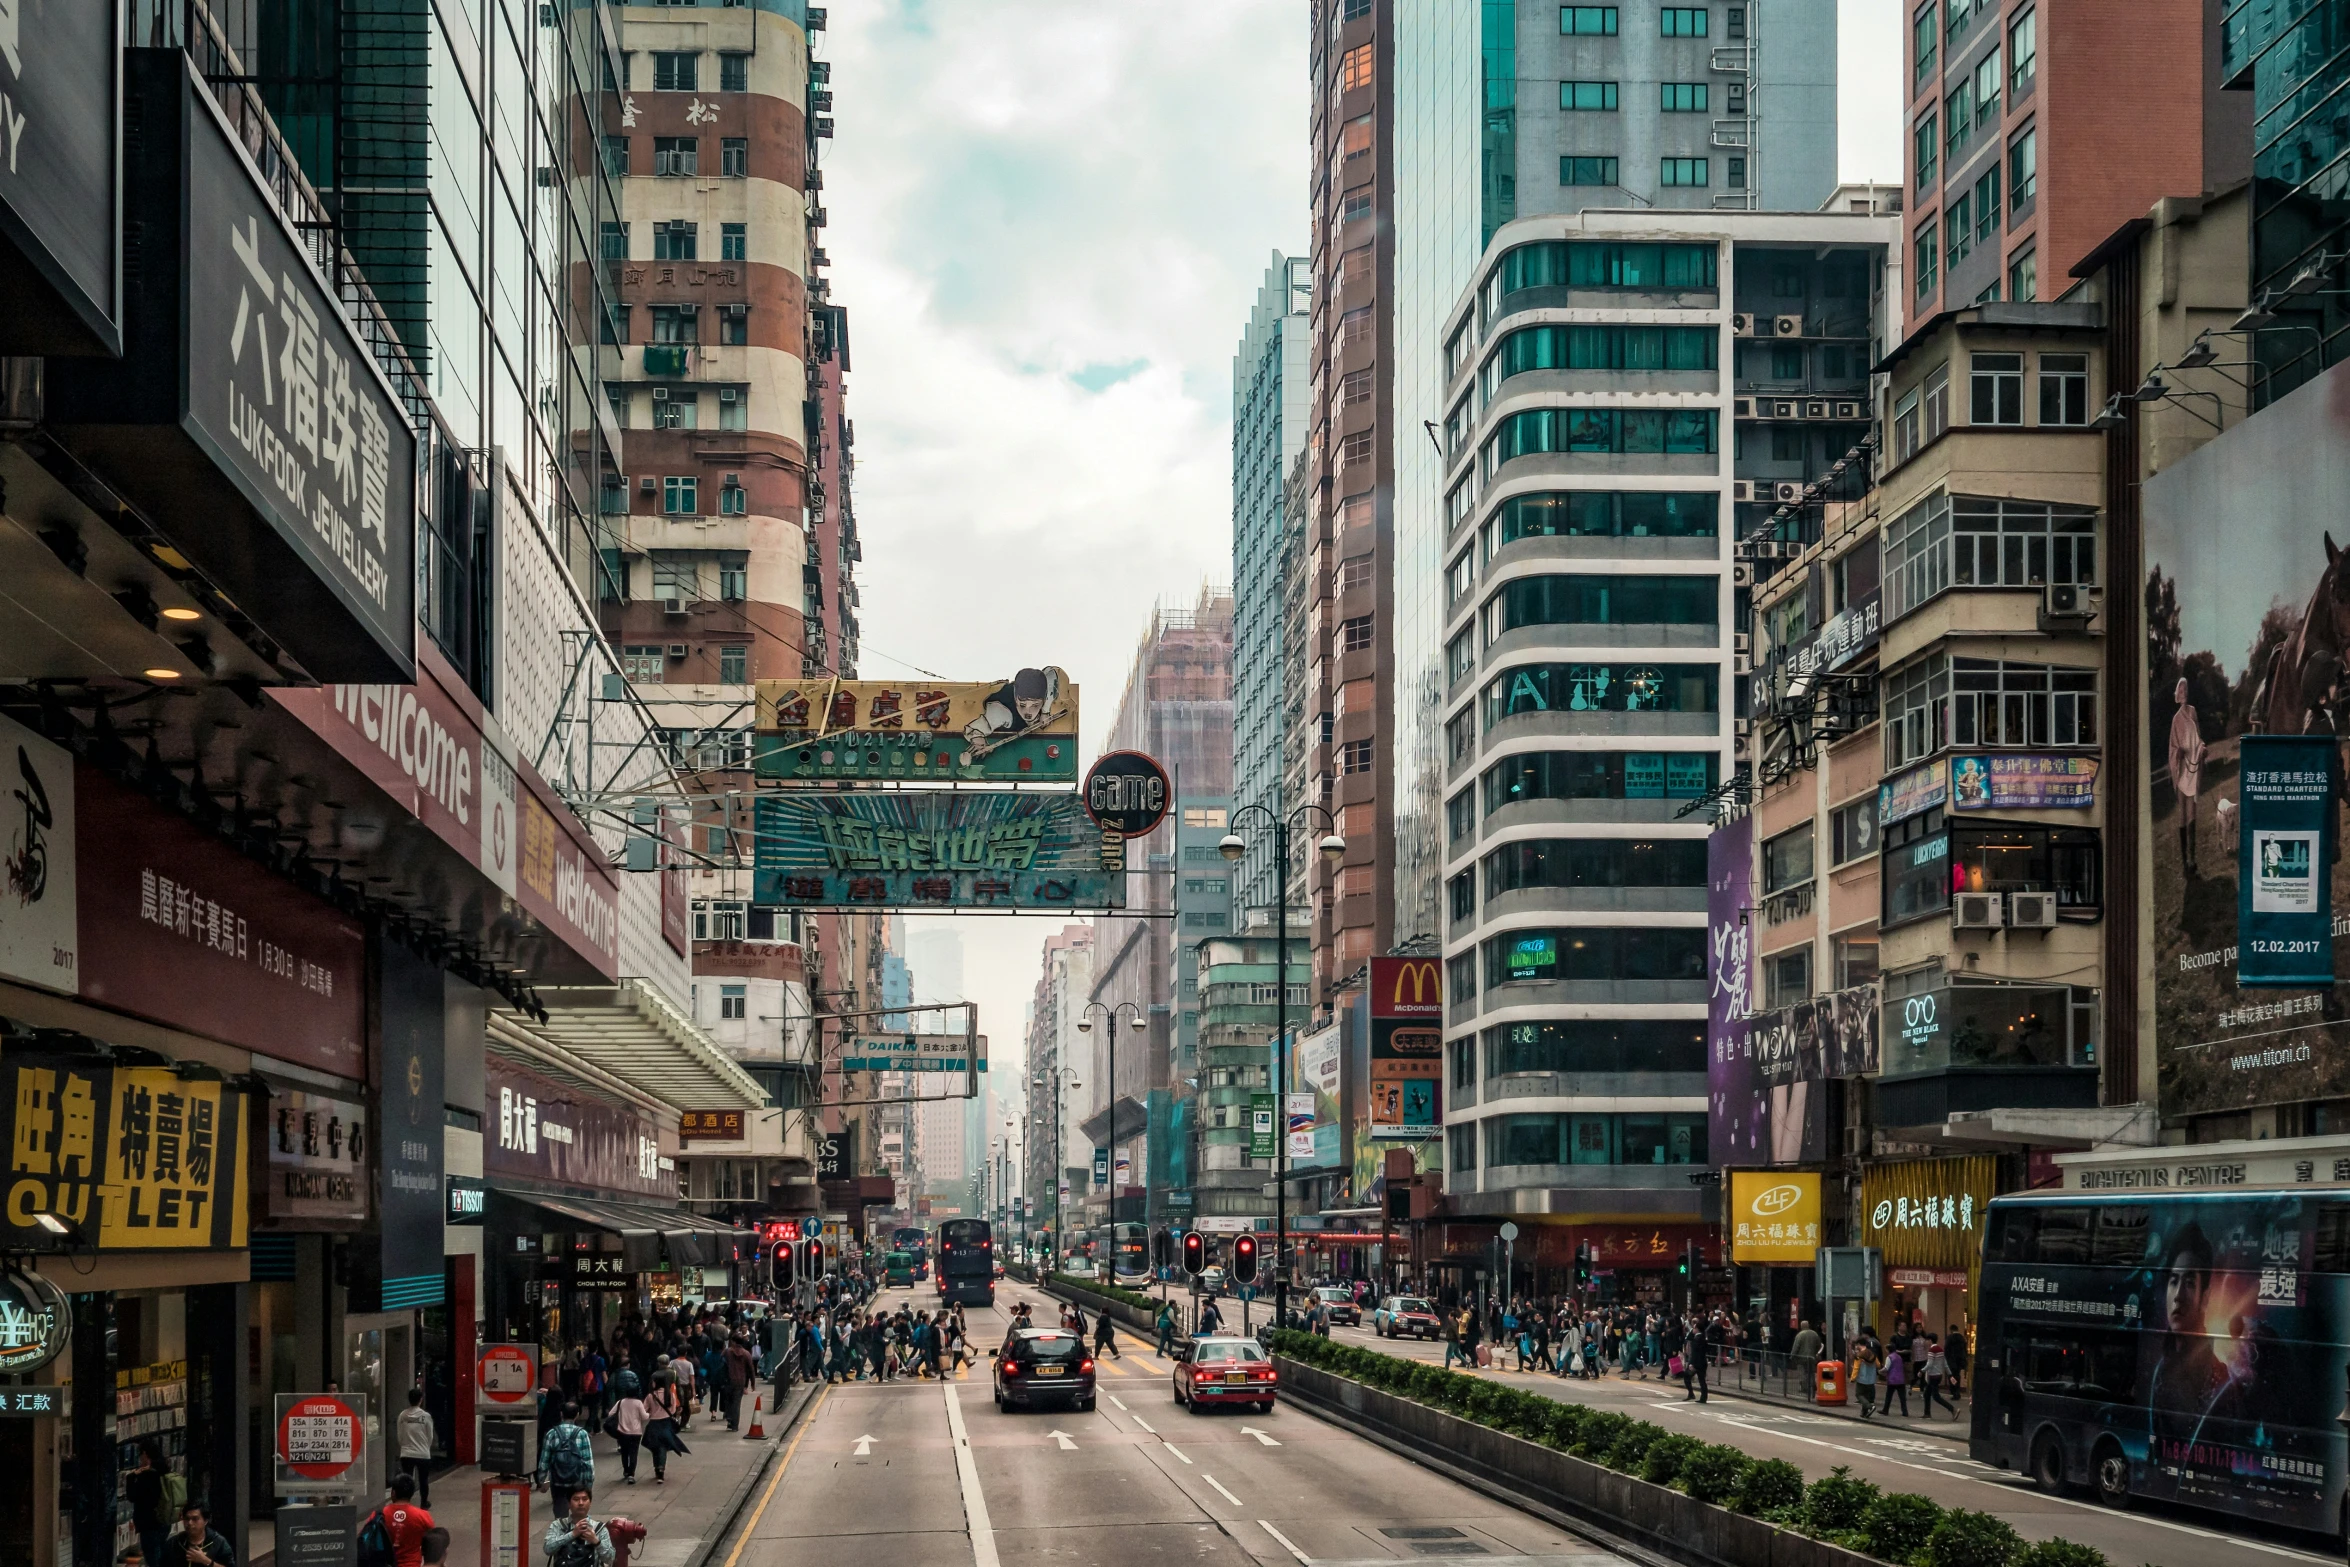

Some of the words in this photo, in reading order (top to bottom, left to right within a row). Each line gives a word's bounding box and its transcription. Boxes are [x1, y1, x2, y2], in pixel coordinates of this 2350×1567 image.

[230, 215, 391, 554] 六福珠寶
[229, 379, 307, 517] LUKFOOK
[312, 488, 389, 611] JEWELLERY
[2246, 771, 2328, 784] 渣打香港馬拉松
[2246, 785, 2282, 793] STANDARD
[2285, 785, 2328, 793] CHARTERED
[523, 793, 556, 904] 惠康
[783, 876, 1071, 901] 遊戲機中心
[556, 849, 615, 959] wellcome
[140, 866, 248, 961] 農曆新年賽馬日
[257, 938, 294, 980] 1月30日
[300, 962, 333, 998] 沙田馬場
[2251, 940, 2320, 953] 12.02.2017
[53, 946, 73, 969] 2017
[2180, 949, 2221, 971] Become
[1394, 1004, 1442, 1012] McDonald's
[2218, 993, 2323, 1028] 瑞士梅花表空中霸王系列
[1511, 1026, 1539, 1034] HOME
[1512, 1033, 1540, 1043] PLACE
[1902, 1029, 1911, 1038] THE
[1913, 1027, 1923, 1037] NEW
[1924, 1023, 1939, 1034] BLACK
[867, 1042, 918, 1052] DAIKIN
[1754, 1022, 1799, 1062] WOW
[2231, 1040, 2310, 1070] www.titoni.ch
[500, 1086, 537, 1154] 周大福
[816, 1139, 839, 1157] BS
[2080, 1167, 2169, 1189] RIGHTEOUS
[2176, 1164, 2246, 1186] CENTRE
[286, 1172, 321, 1200] NATHAN
[7, 1179, 208, 1228] OUTLET
[462, 1190, 484, 1213] TISSOT
[1764, 1191, 1790, 1209] ZLF
[1894, 1193, 1974, 1231] 周六福珠寶
[1735, 1222, 1818, 1239] 周六福珠寶
[2262, 1229, 2300, 1261] 地表
[2011, 1276, 2045, 1293] AXA安盛
[2258, 1267, 2298, 1299] 最強
[492, 1363, 499, 1372] 1
[510, 1363, 523, 1373] 1A
[492, 1379, 499, 1388] 2
[15, 1393, 51, 1410] 汇款
[292, 1417, 307, 1426] 35A
[313, 1417, 328, 1426] 35X
[334, 1417, 349, 1426] 41A
[292, 1429, 307, 1438] 81S
[313, 1429, 328, 1438] 87D
[334, 1429, 349, 1438] 87E
[290, 1441, 309, 1449] 234P
[310, 1441, 330, 1449] 234X
[331, 1440, 350, 1449] 281A
[290, 1452, 309, 1461] N216
[310, 1452, 331, 1461] N241
